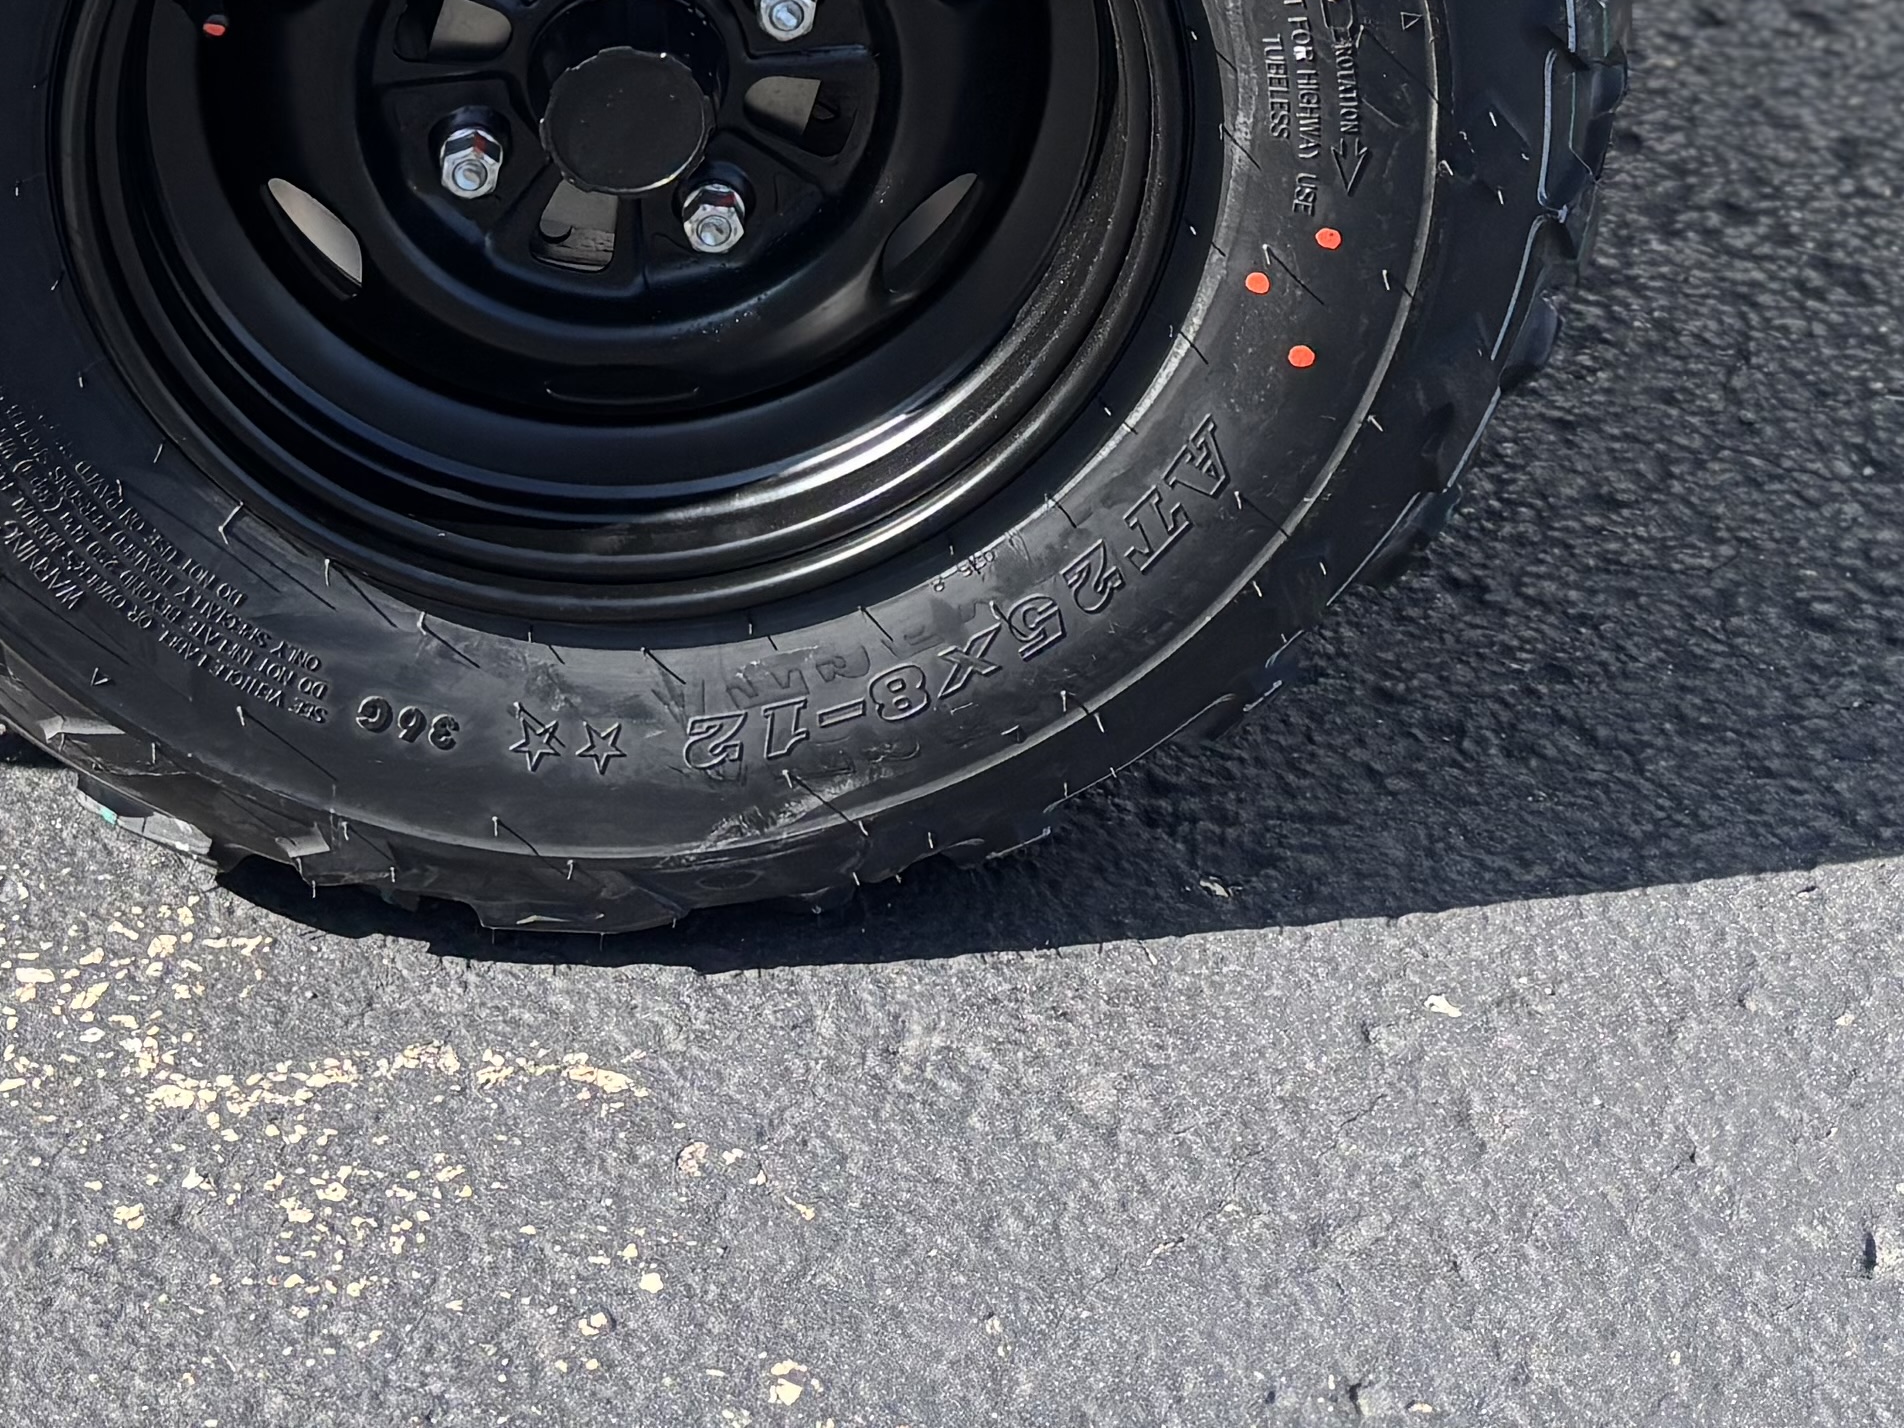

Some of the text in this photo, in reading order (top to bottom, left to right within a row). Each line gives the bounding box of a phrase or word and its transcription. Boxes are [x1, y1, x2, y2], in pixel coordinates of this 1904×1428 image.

[1288, 16, 1315, 61] FOR
[1262, 36, 1290, 139] TUBELESS
[1297, 69, 1320, 160] HIGHWAY
[1334, 42, 1361, 135] ROTATION
[1293, 174, 1318, 217] USE
[125, 602, 155, 631] OR
